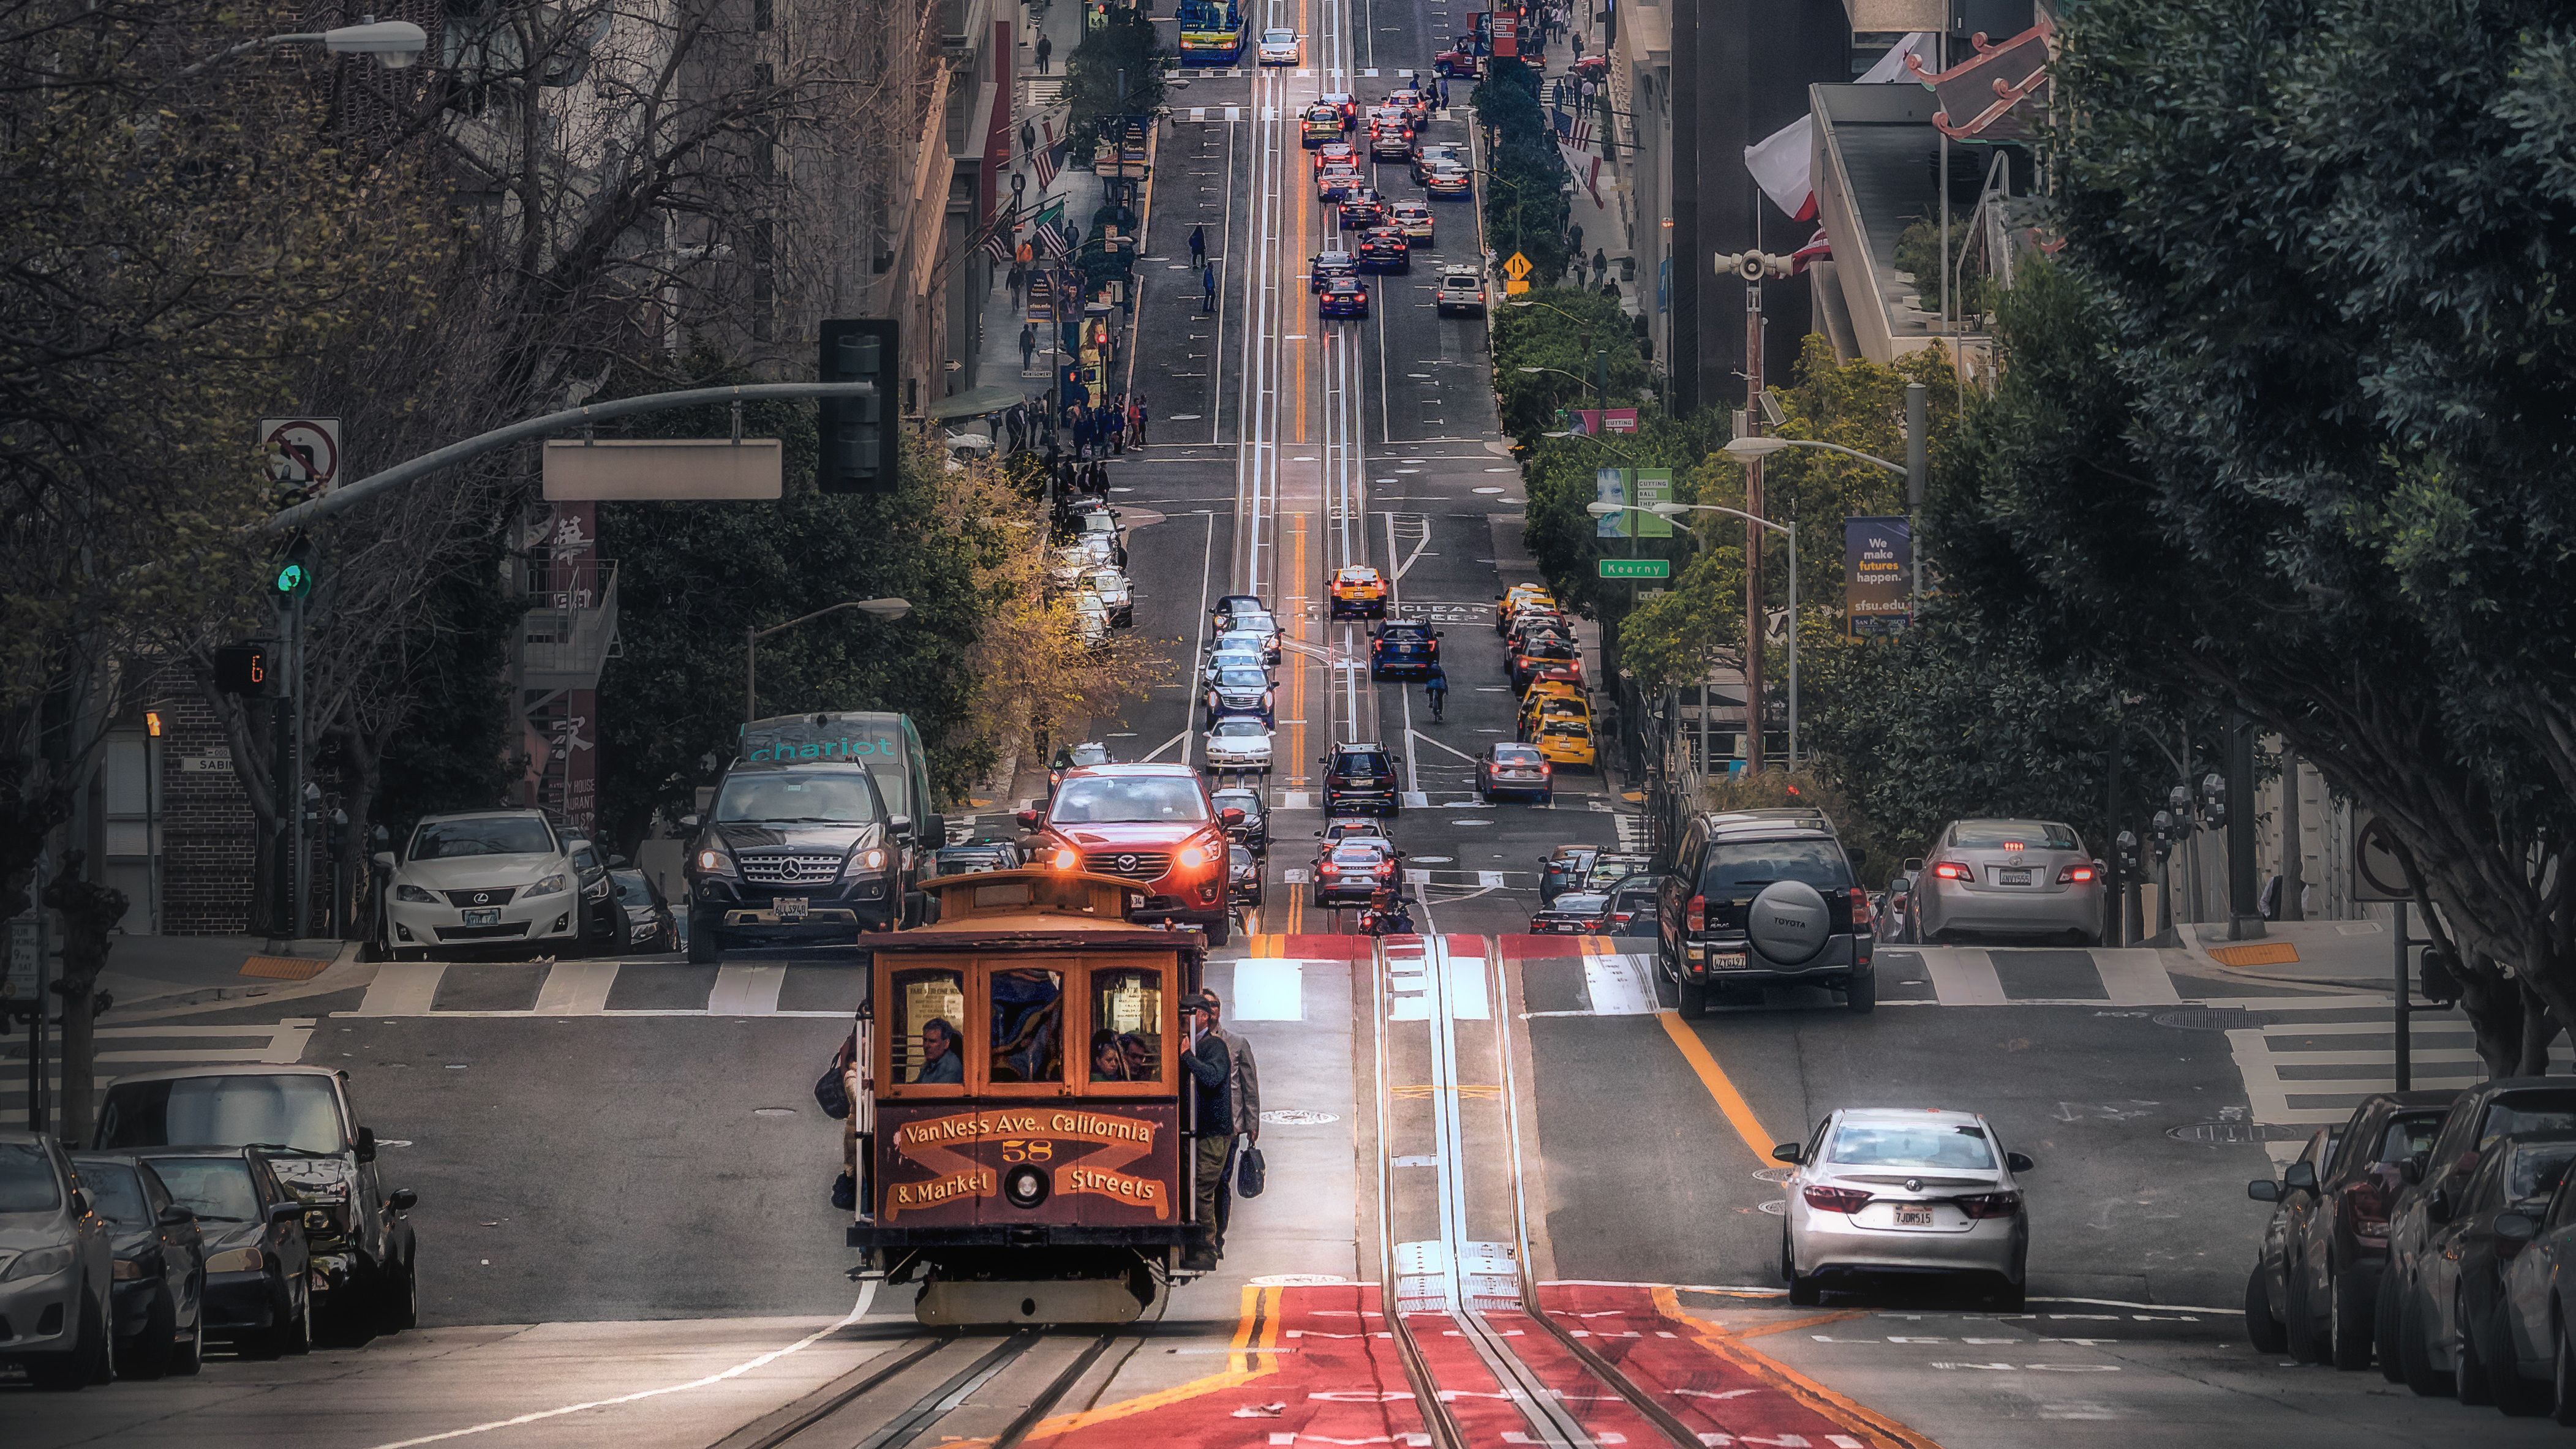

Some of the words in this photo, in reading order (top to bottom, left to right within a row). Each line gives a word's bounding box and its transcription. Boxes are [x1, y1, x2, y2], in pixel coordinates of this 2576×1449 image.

[1869, 538, 1888, 549] We
[1864, 549, 1894, 560] make
[1608, 564, 1660, 576] Kearny
[1859, 560, 1899, 571] futures
[1856, 572, 1902, 585] happen.
[1401, 605, 1488, 614] CLEAR
[1855, 600, 1906, 611] sfsu.edu
[252, 655, 263, 683] 6
[750, 737, 895, 762] chariot
[573, 778, 595, 794] HOUSE
[1774, 917, 1806, 928] TOYOTA
[13, 948, 20, 960] 9
[906, 1126, 940, 1145] Van
[943, 1116, 990, 1142] Ness
[1052, 1114, 1150, 1143] California
[1003, 1140, 1053, 1162] 58
[898, 1183, 912, 1203] &
[917, 1172, 989, 1203] Market
[1071, 1169, 1156, 1200] Streets
[1896, 1213, 1931, 1224] 7JDR515
